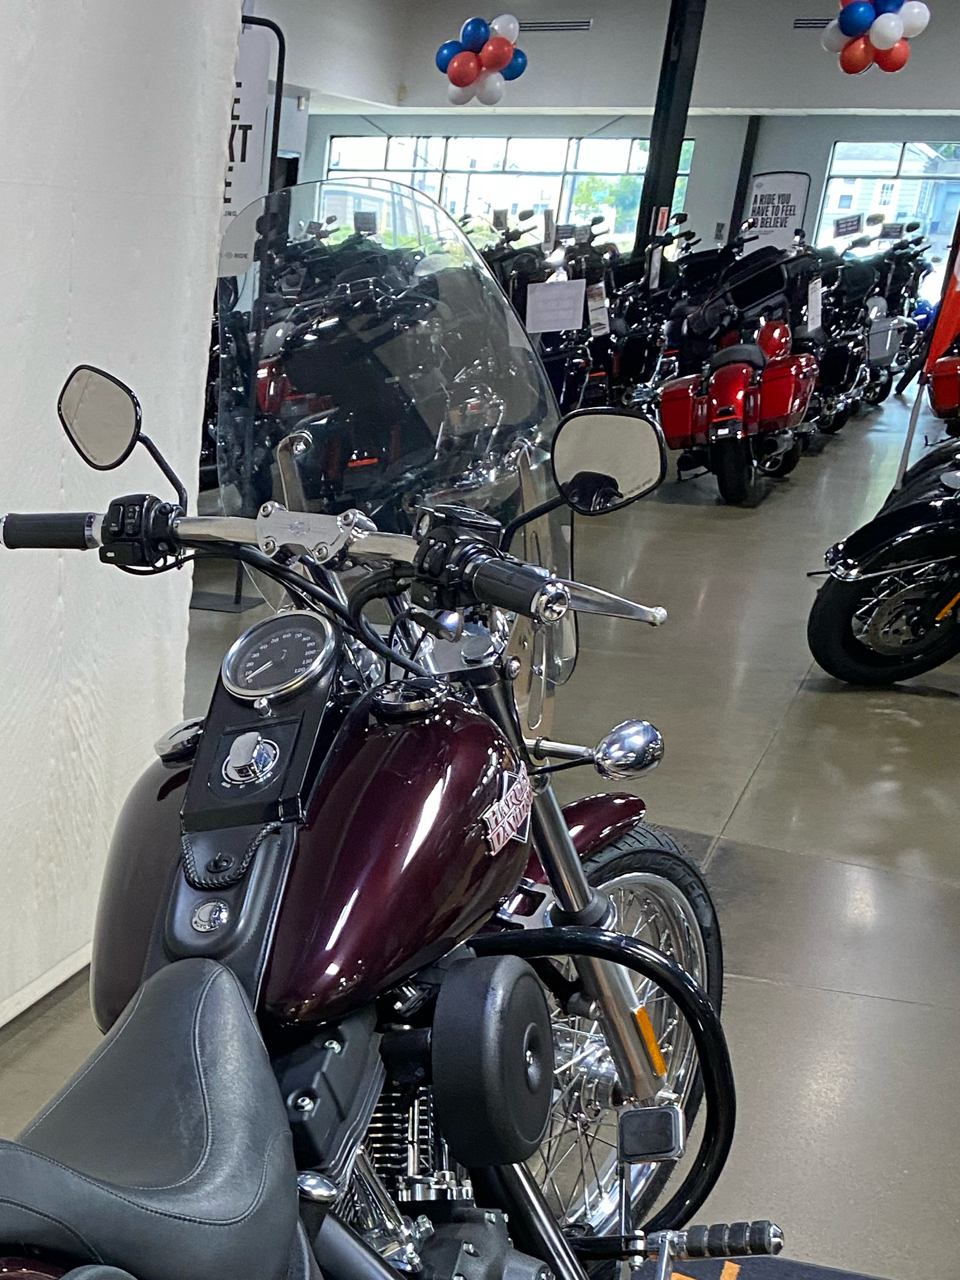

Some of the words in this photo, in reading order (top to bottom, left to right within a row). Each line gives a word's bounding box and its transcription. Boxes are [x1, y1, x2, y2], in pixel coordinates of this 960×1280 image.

[752, 194, 759, 206] A
[759, 193, 777, 205] RIDE
[777, 193, 792, 205] YOU
[751, 205, 770, 217] HAVE
[771, 204, 781, 217] TO
[781, 204, 797, 216] FEEL
[759, 216, 790, 228] BELIEVE
